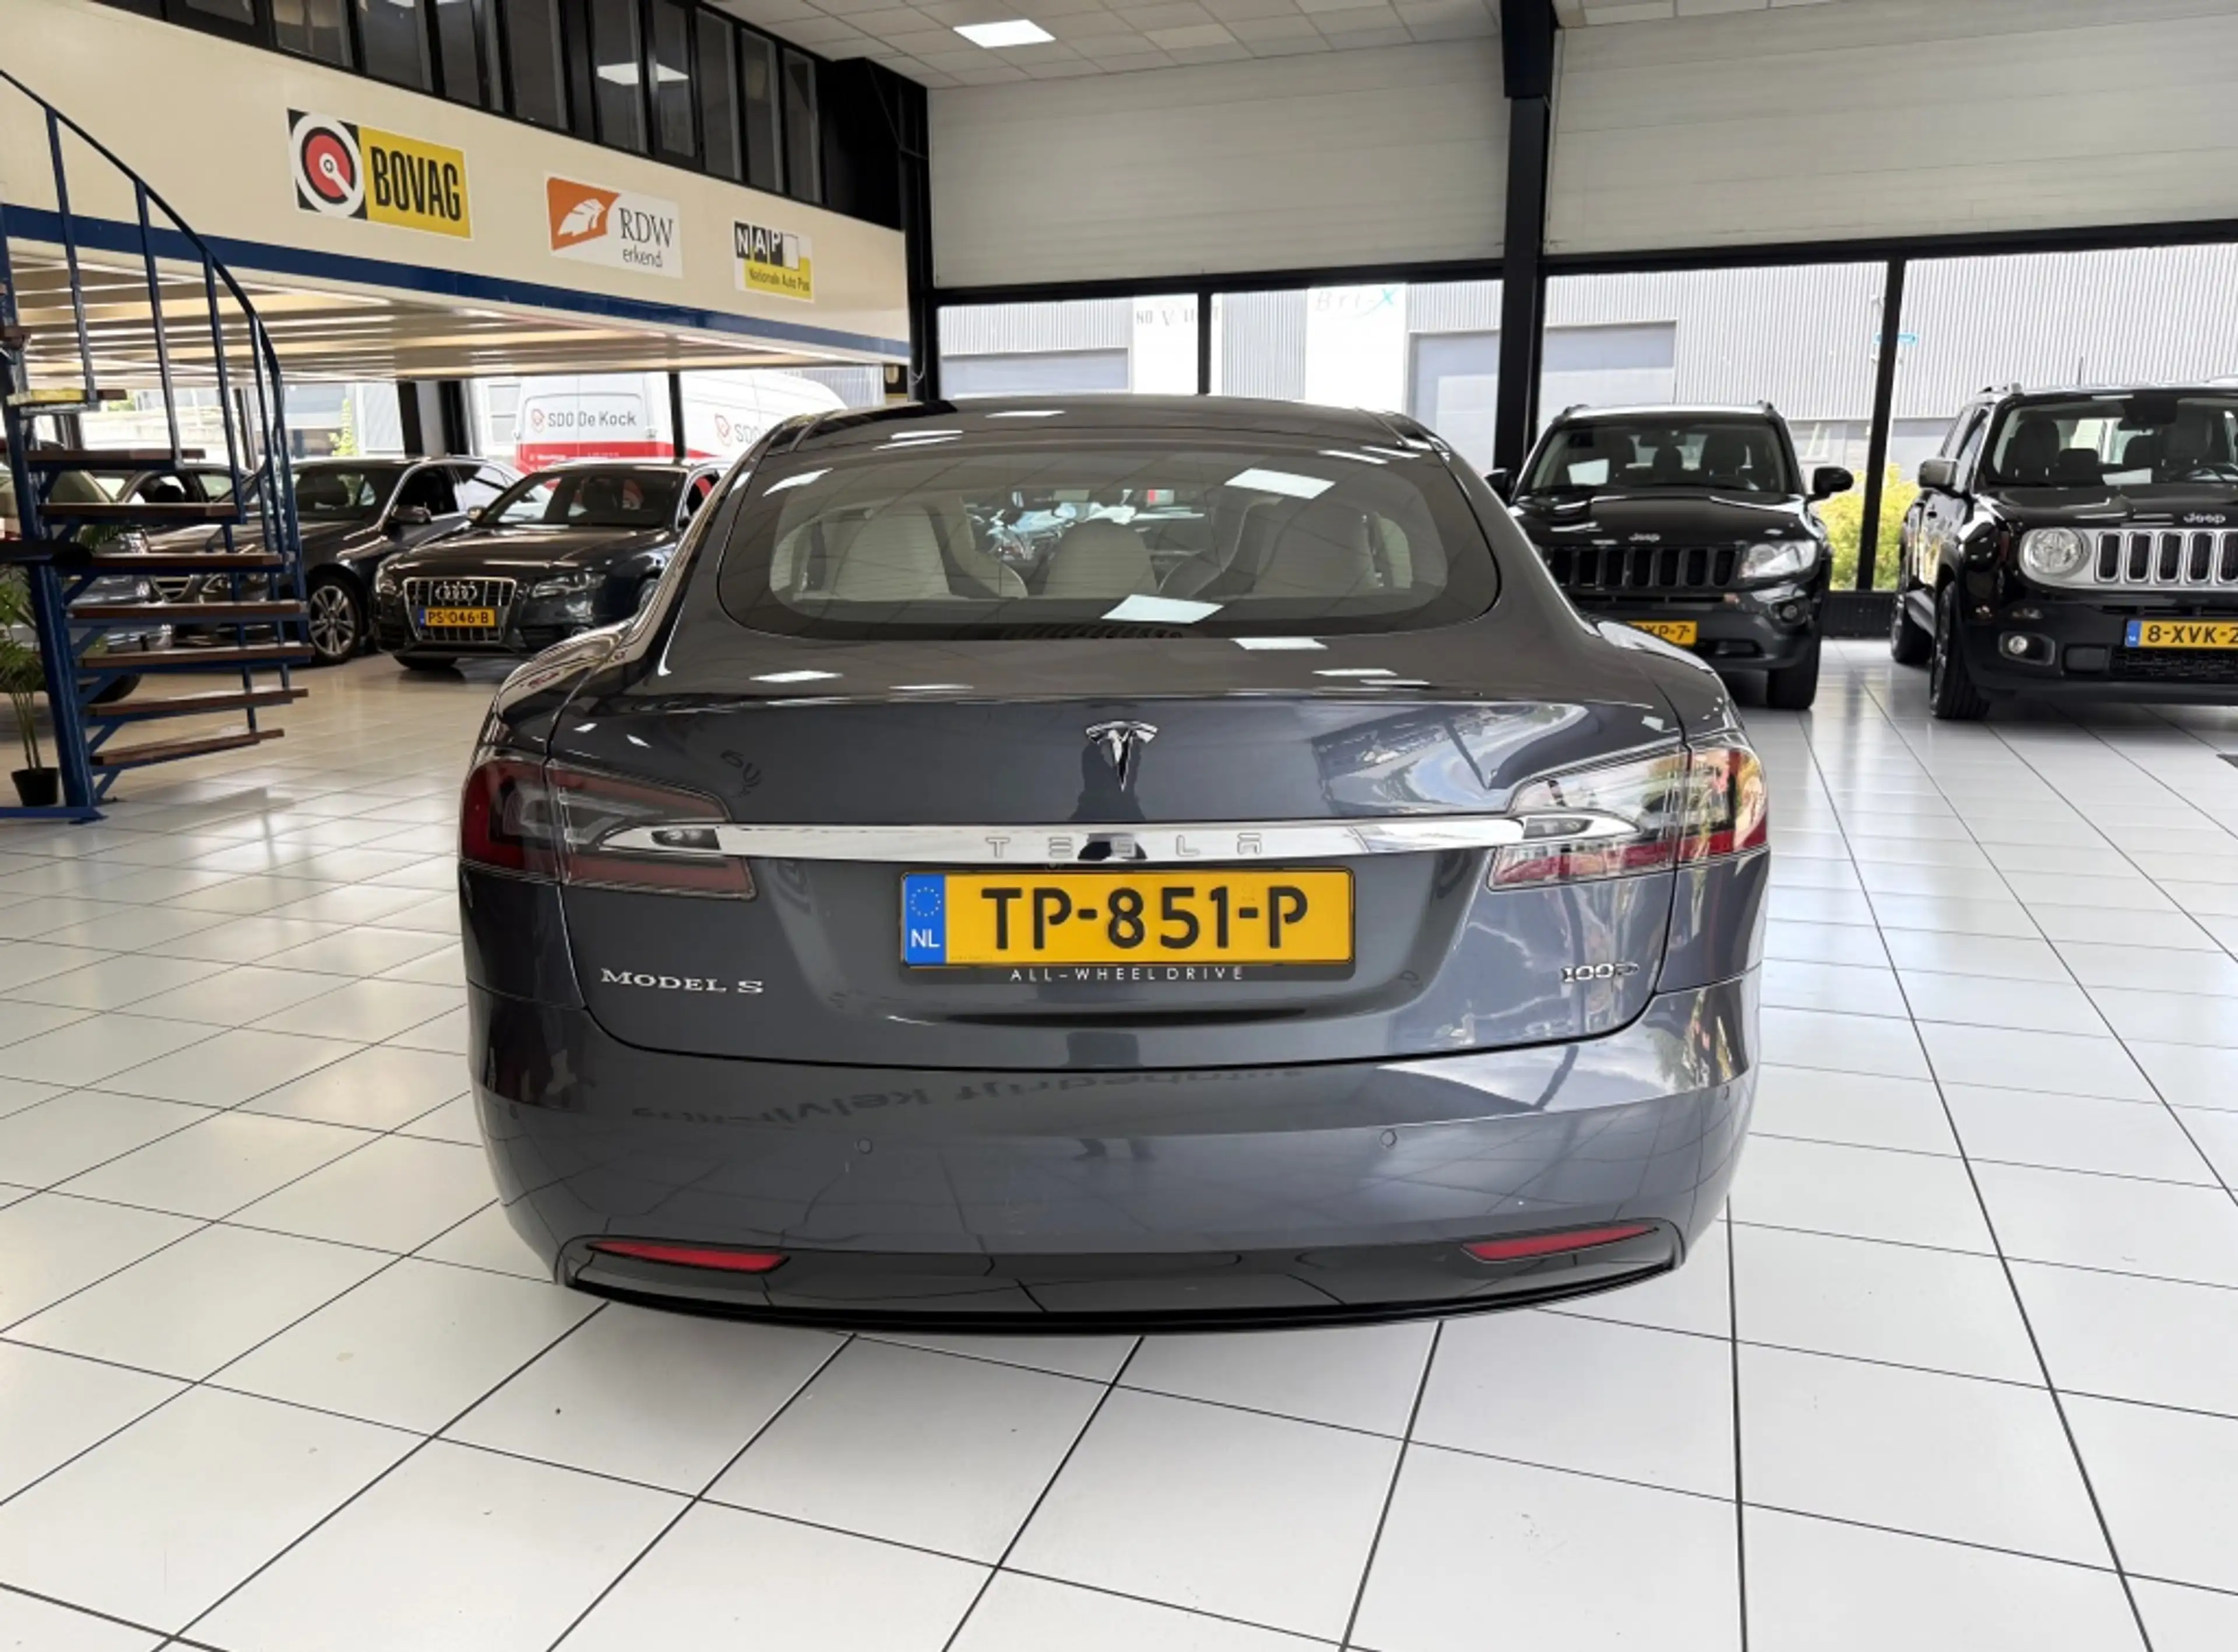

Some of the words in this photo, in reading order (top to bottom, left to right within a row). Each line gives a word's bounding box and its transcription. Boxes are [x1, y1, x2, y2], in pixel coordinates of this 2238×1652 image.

[370, 146, 461, 221] BOVAG
[618, 207, 674, 248] RDW
[623, 245, 663, 268] erkend
[599, 410, 637, 427] Kock
[2183, 511, 2226, 525] Jeep
[2147, 625, 2238, 644] 8-XVK-2
[986, 832, 1262, 858] TESLA
[981, 886, 1308, 950] TP-851-P
[910, 929, 941, 948] NL
[600, 968, 727, 992] MODEL
[737, 980, 764, 994] S
